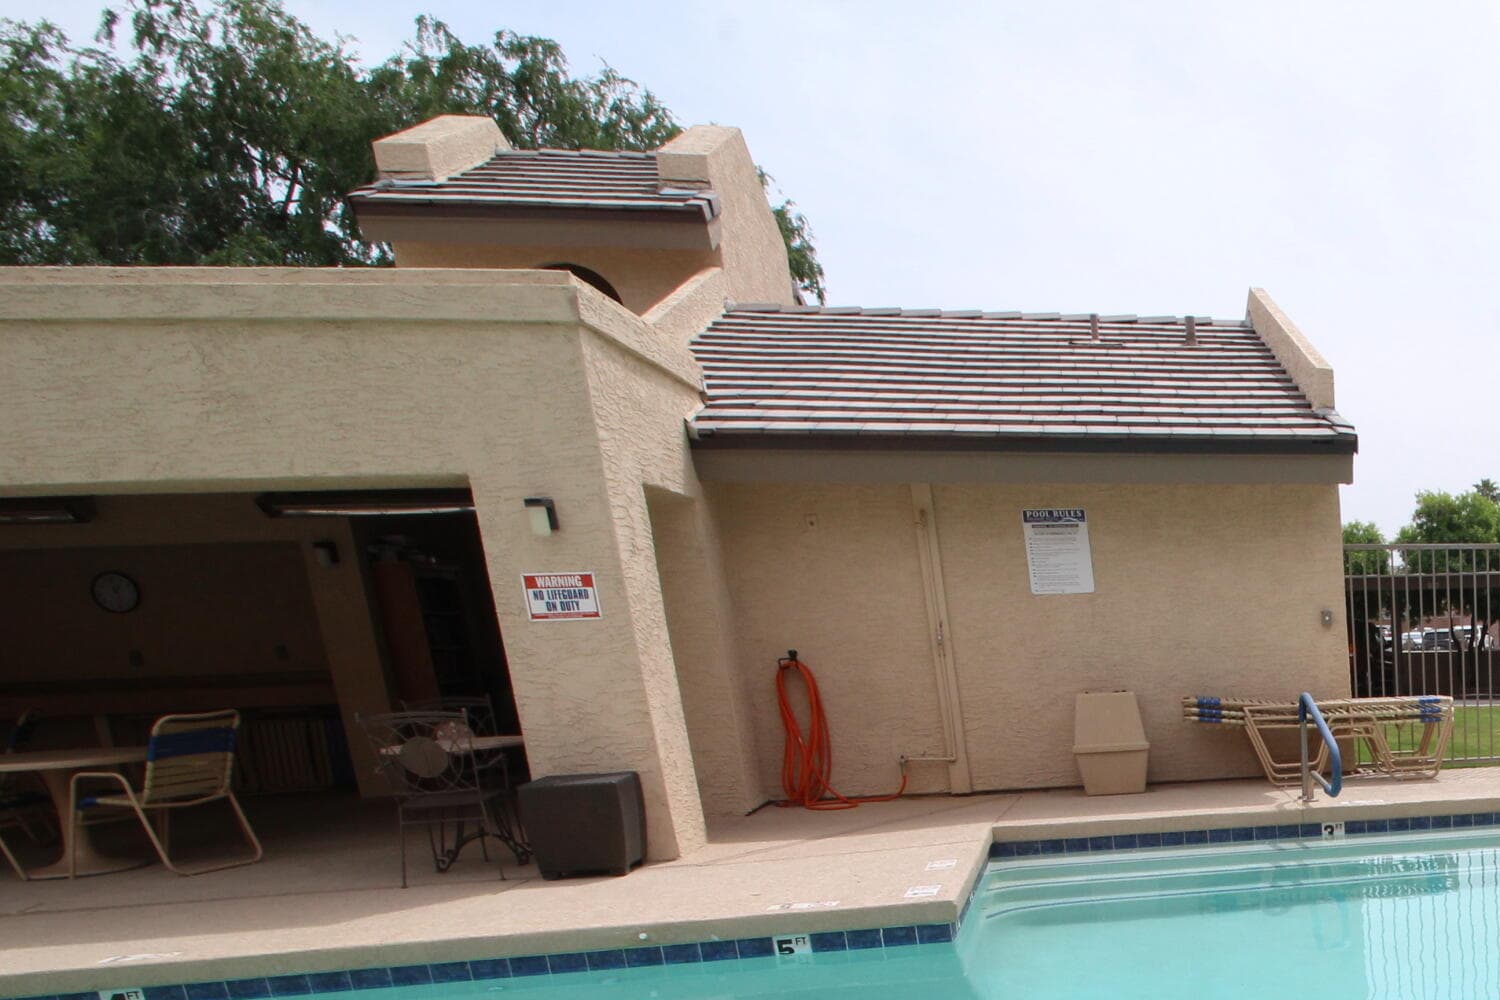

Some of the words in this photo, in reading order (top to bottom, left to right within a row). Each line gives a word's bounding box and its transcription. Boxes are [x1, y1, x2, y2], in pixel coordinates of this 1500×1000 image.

[1026, 511, 1049, 519] POOL
[534, 575, 583, 588] WARNING
[532, 590, 544, 600] NO
[546, 589, 589, 600] LIFEGUARD
[546, 601, 557, 612] ON
[559, 600, 580, 611] DUTY
[776, 939, 795, 955] 5
[795, 936, 807, 945] FT
[126, 991, 140, 999] FT
